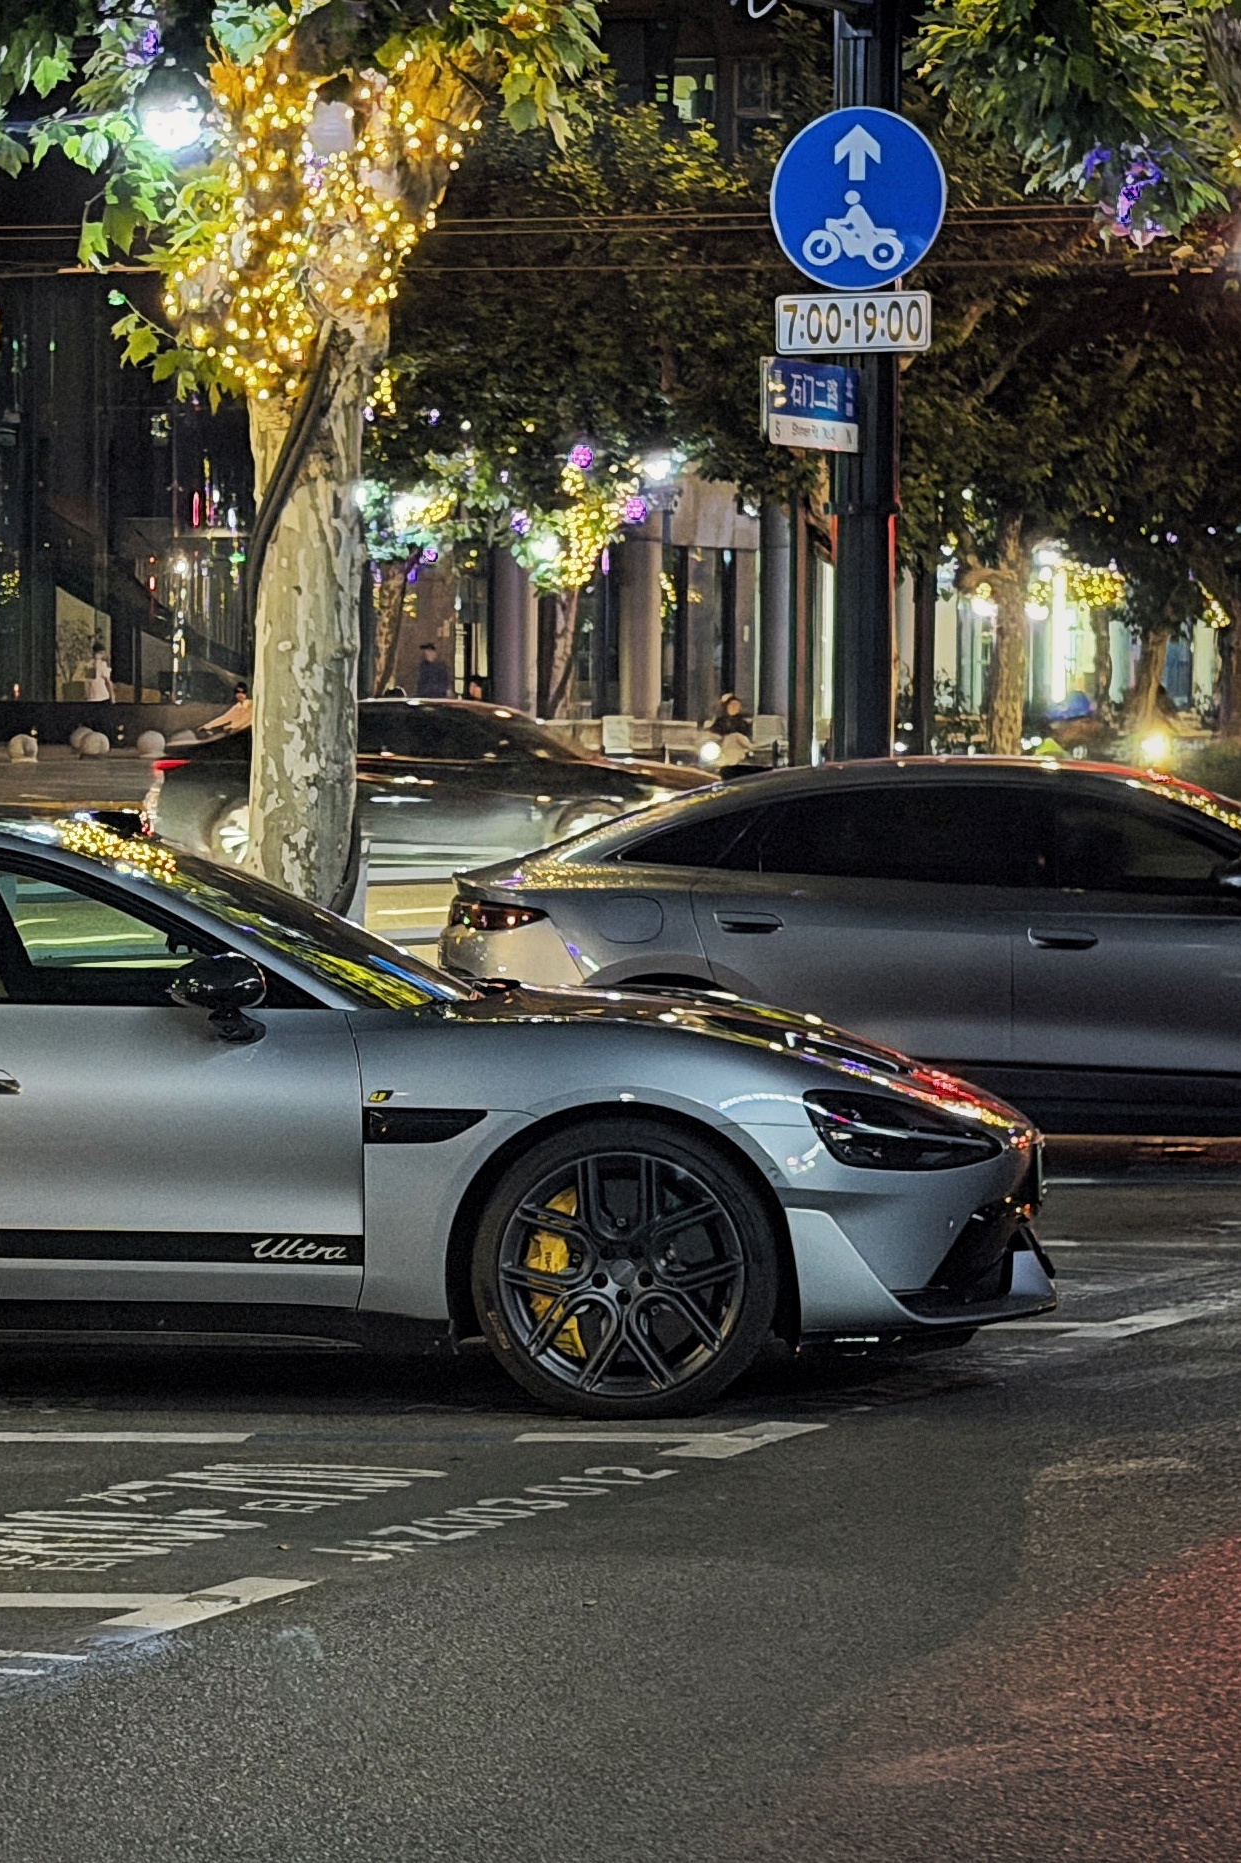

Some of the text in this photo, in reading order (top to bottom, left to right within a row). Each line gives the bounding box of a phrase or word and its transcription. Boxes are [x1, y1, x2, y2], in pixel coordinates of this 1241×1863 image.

[783, 301, 922, 345] 7:00-19:00
[790, 373, 839, 411] 石门二路
[251, 1238, 348, 1260] Ultra
